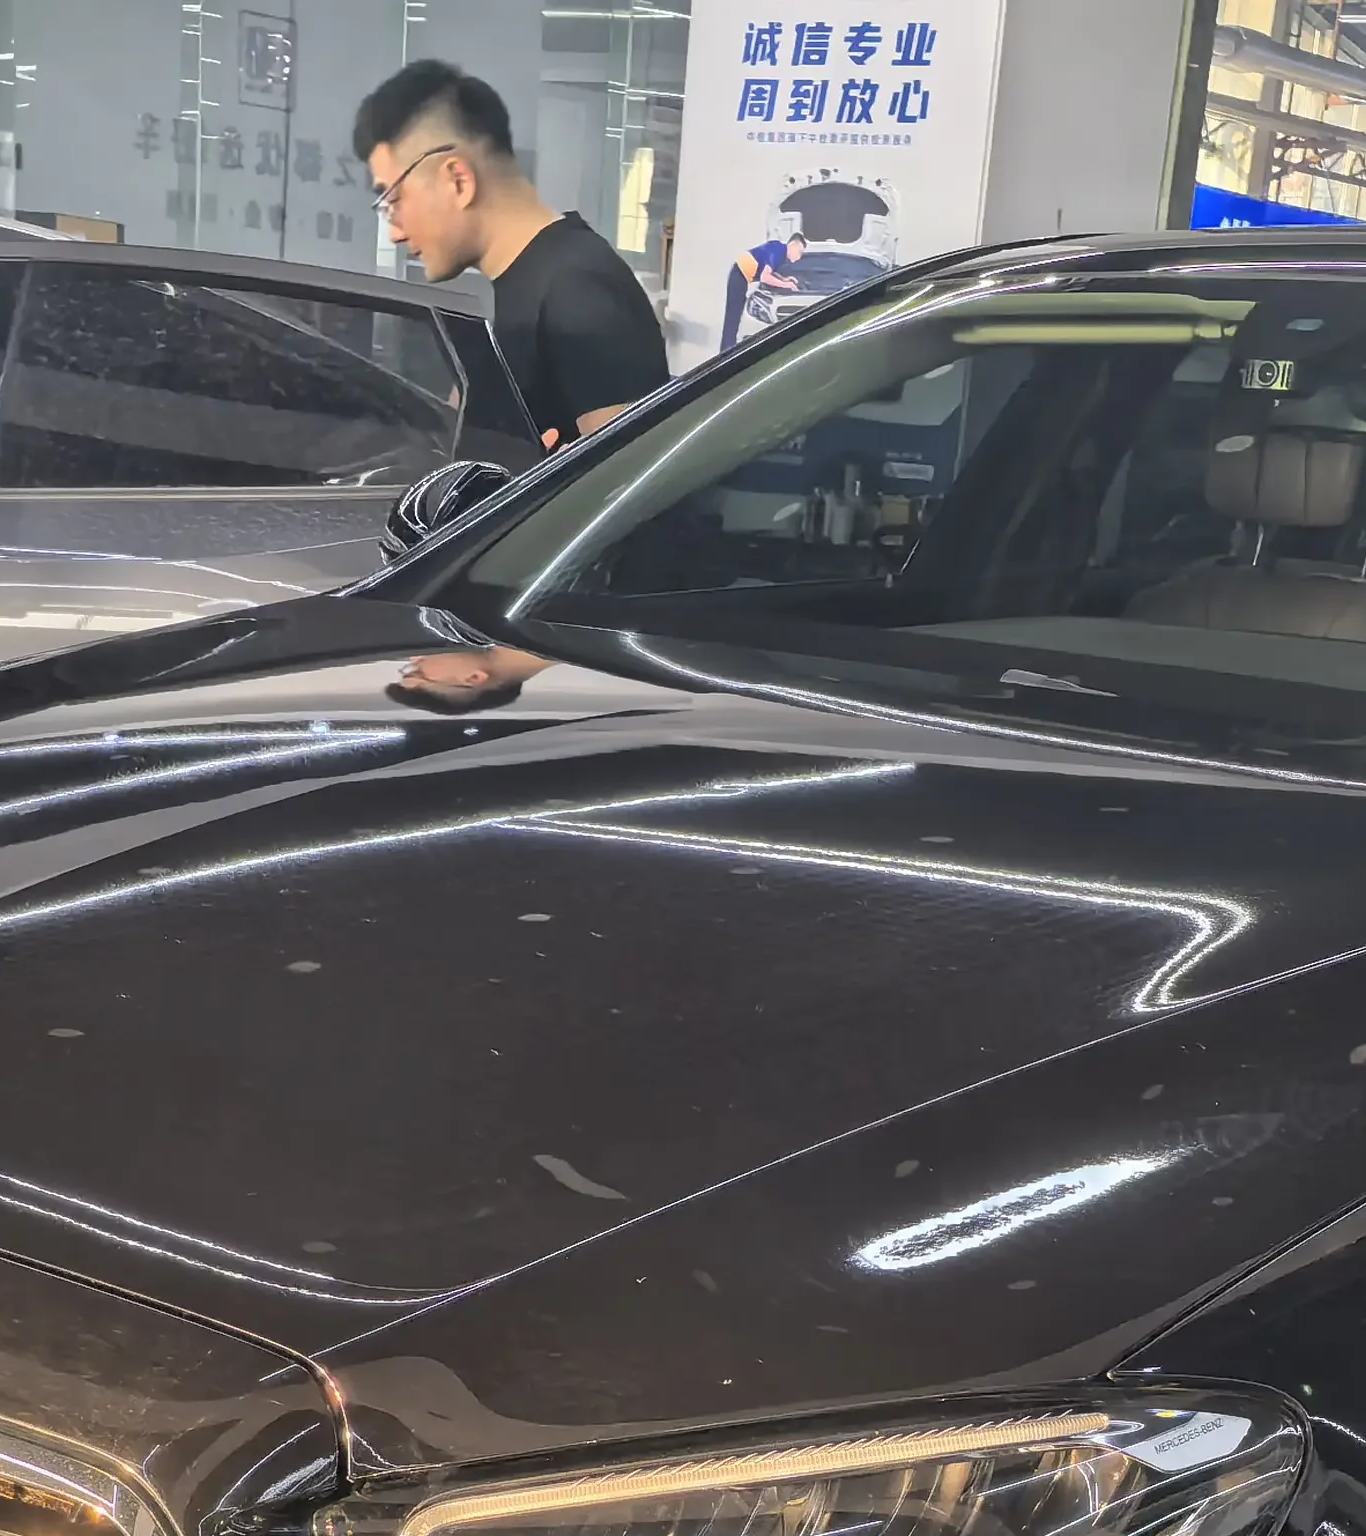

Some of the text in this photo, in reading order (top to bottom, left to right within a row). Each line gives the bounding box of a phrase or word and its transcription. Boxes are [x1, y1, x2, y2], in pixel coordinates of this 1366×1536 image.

[741, 21, 938, 67] 诚信专业
[736, 78, 931, 124] 周到放心
[1153, 1417, 1225, 1455] MERCEDES-BENZ
